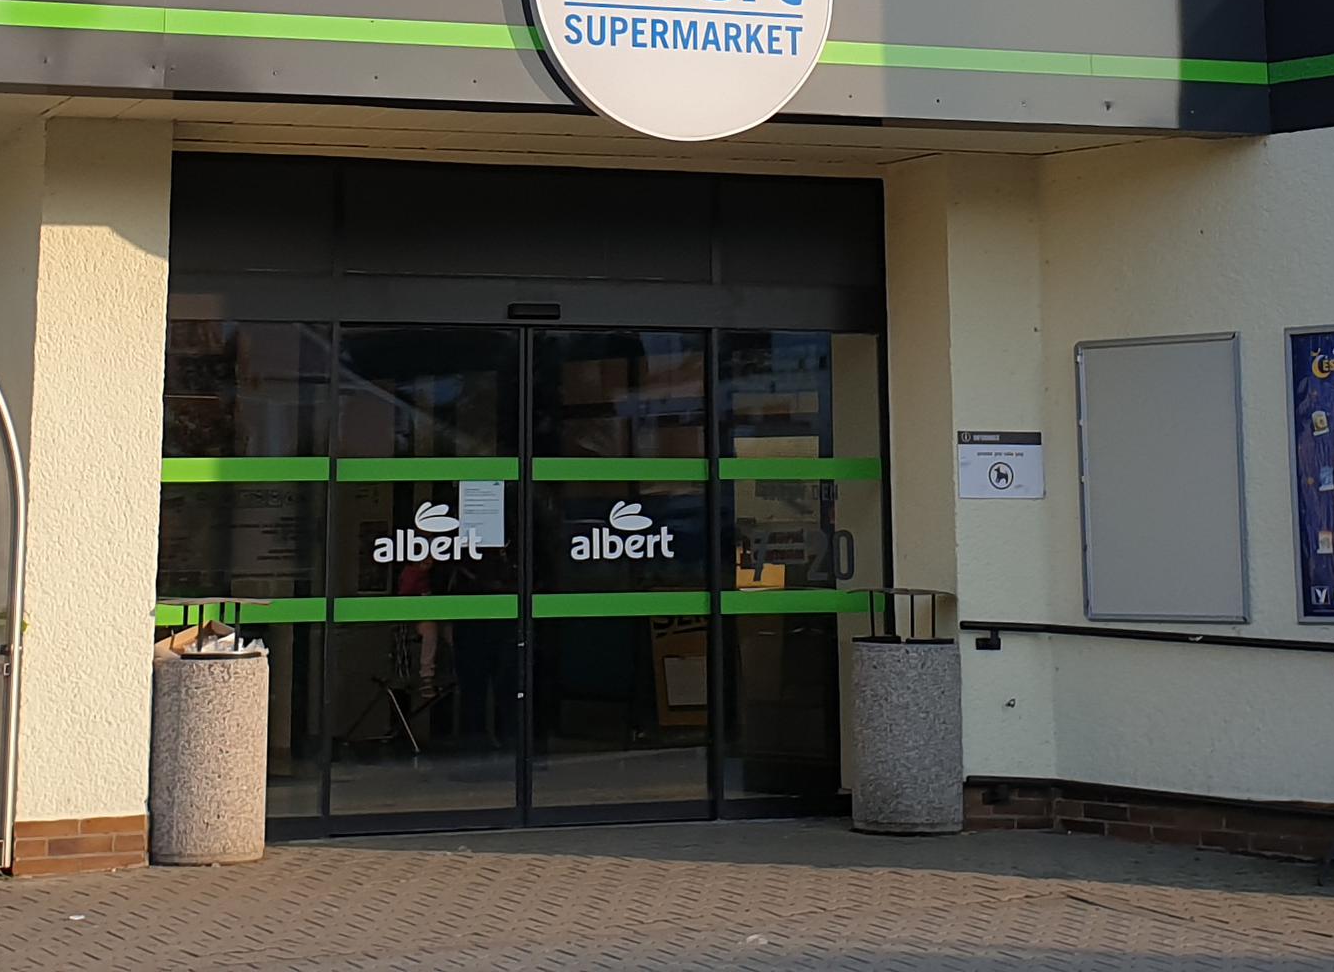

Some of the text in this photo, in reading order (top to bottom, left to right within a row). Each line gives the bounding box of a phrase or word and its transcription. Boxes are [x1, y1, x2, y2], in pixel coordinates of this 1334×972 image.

[564, 13, 803, 57] SUPERMARKET
[373, 528, 483, 563] albert
[570, 526, 674, 561] albert
